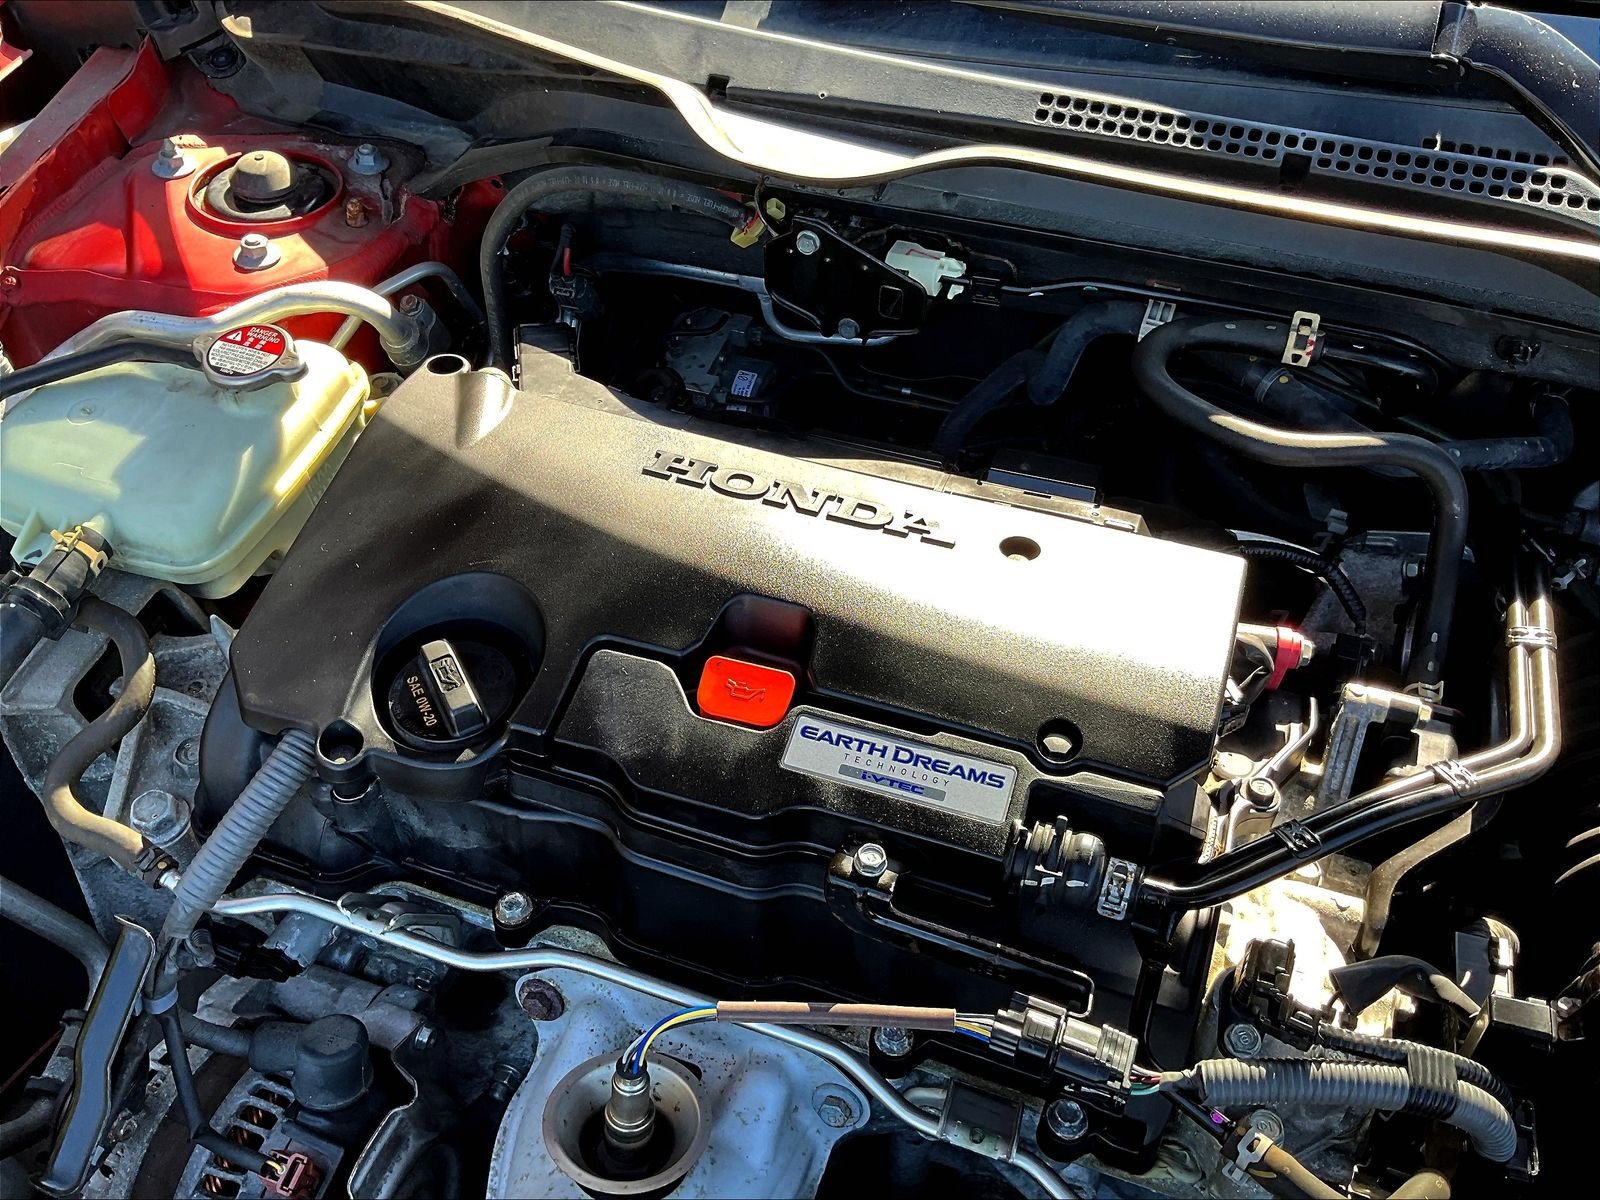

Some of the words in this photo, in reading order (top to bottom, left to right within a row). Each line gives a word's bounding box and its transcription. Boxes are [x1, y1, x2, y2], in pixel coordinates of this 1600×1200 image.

[250, 327, 279, 337] DANGER
[641, 449, 956, 550] HONDA
[406, 675, 424, 698] SAE
[416, 696, 438, 727] 0W-20
[799, 724, 889, 760] EARTH
[892, 745, 1006, 789] DREAMS
[843, 752, 951, 787] TECHNOLOGY
